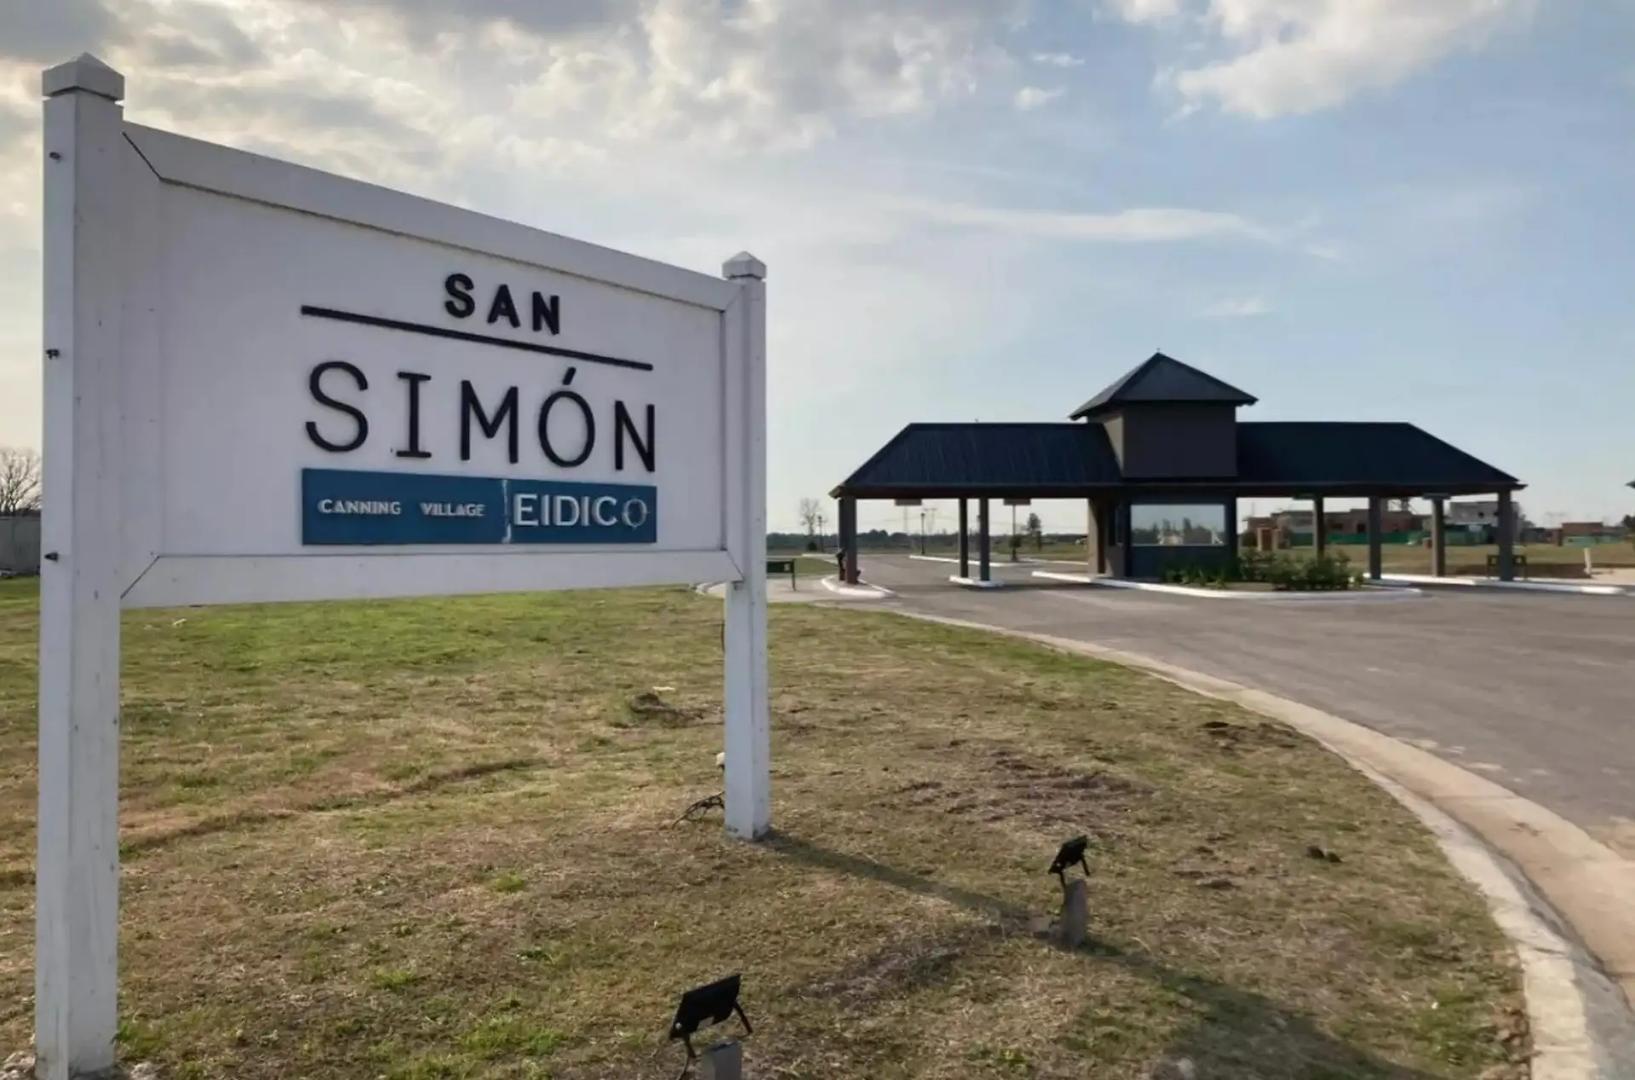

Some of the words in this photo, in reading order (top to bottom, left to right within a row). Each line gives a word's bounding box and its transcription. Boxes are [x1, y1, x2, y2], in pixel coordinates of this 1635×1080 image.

[444, 273, 560, 335] SAN
[305, 361, 656, 472] SIMÓN
[317, 498, 401, 515] CANNING
[420, 502, 486, 517] VILLAGE
[513, 493, 649, 528] EIDICO
